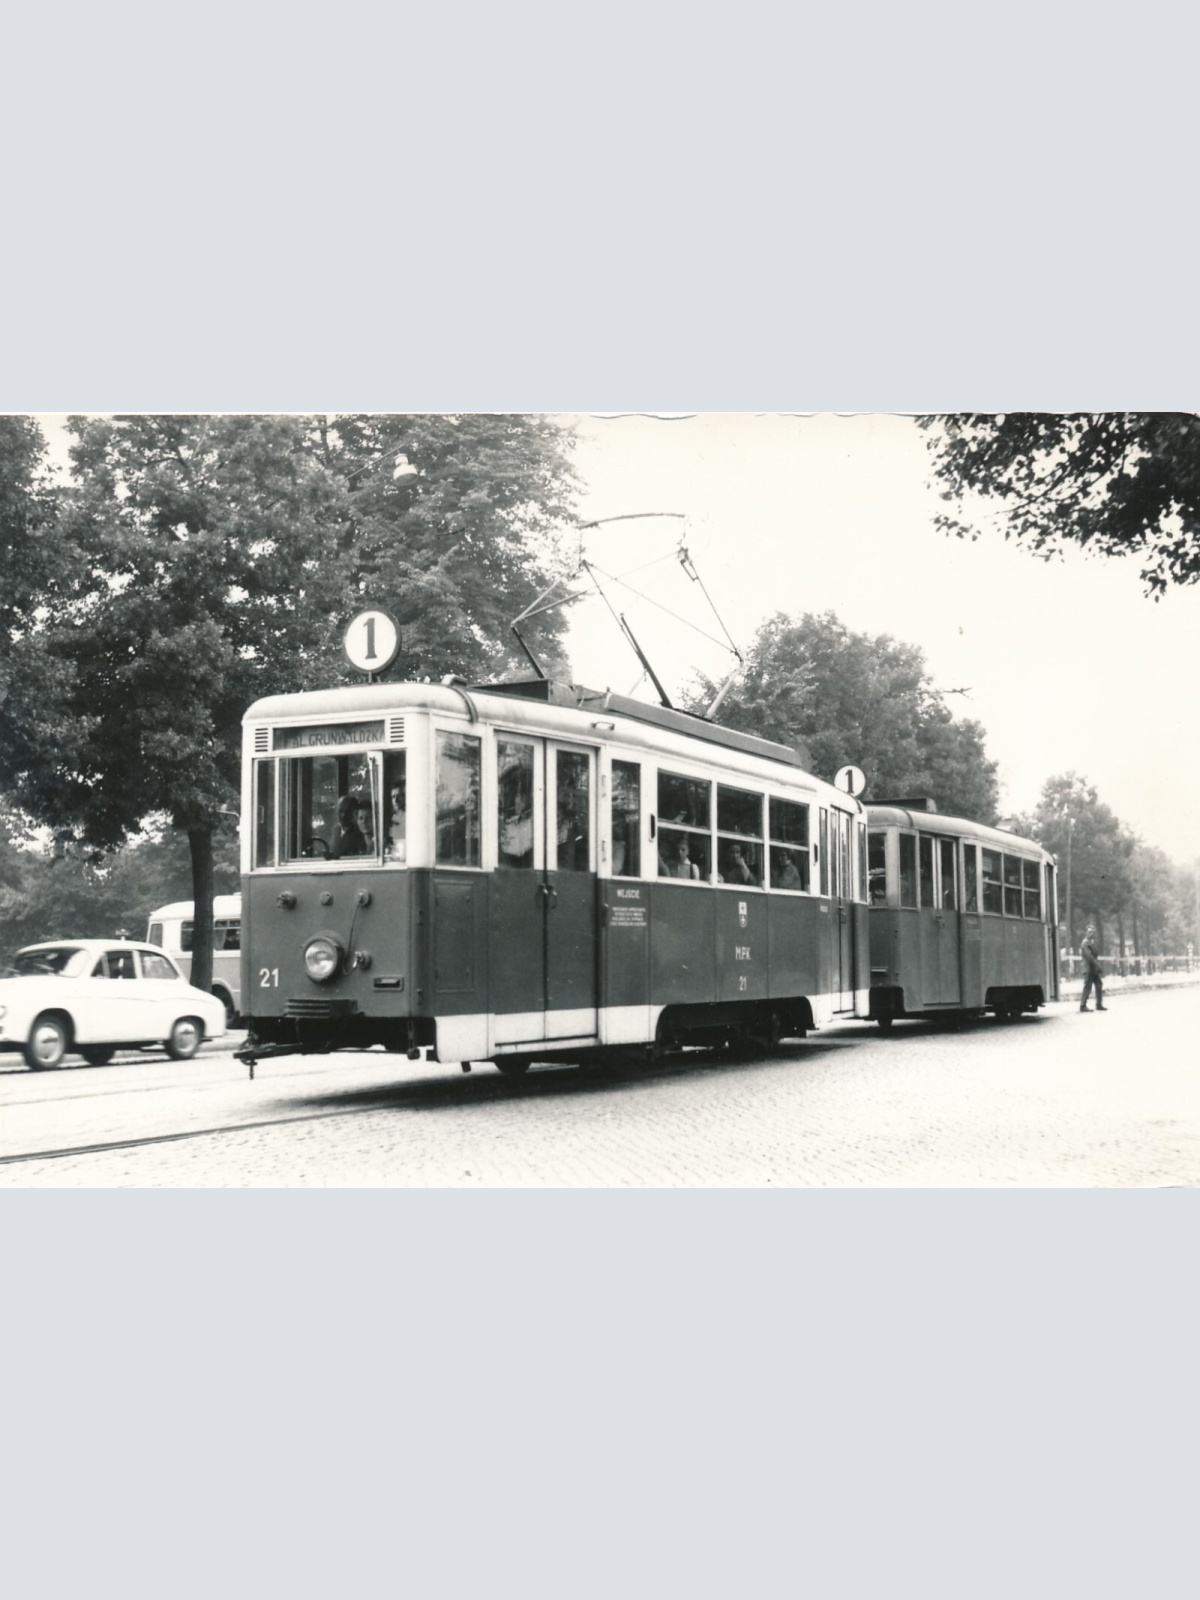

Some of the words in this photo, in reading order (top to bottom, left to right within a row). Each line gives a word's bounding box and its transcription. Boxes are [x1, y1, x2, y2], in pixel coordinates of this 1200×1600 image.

[363, 617, 378, 660] 1
[845, 769, 855, 794] 1
[259, 967, 279, 988] 21
[739, 975, 747, 991] 21
